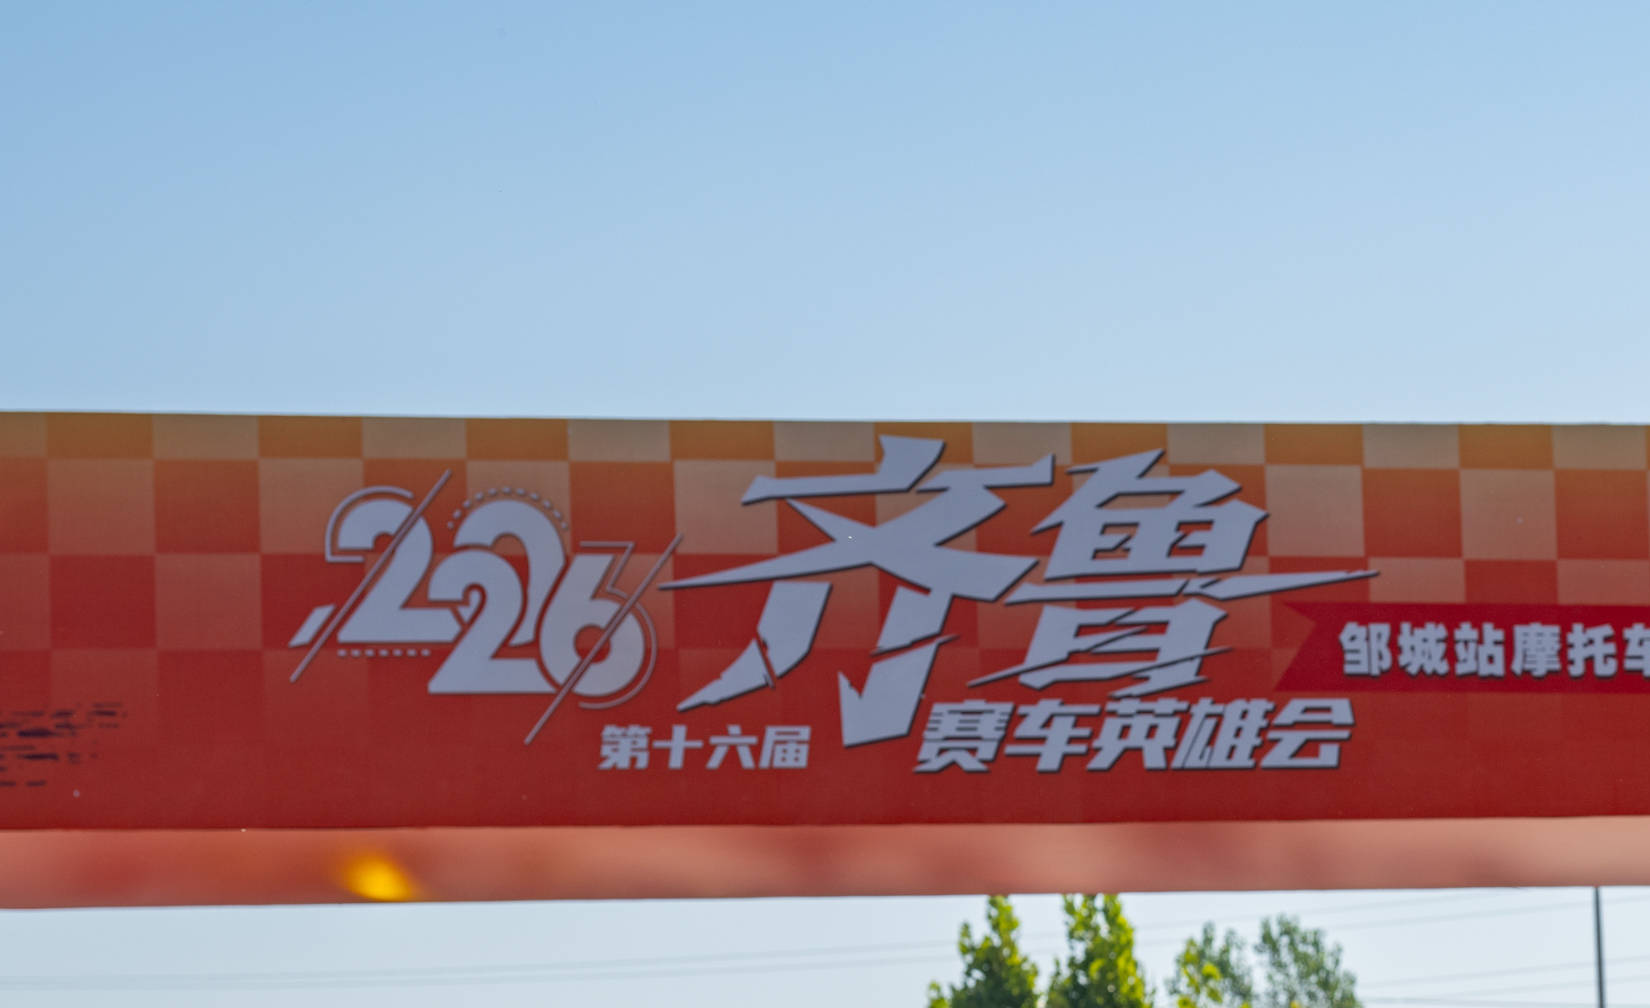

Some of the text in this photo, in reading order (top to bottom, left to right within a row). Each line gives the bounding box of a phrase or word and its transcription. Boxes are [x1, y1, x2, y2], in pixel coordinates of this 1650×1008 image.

[656, 434, 1380, 750] 齐鲁
[597, 722, 813, 771] 第十六届
[911, 697, 1356, 774] 赛车英雄会
